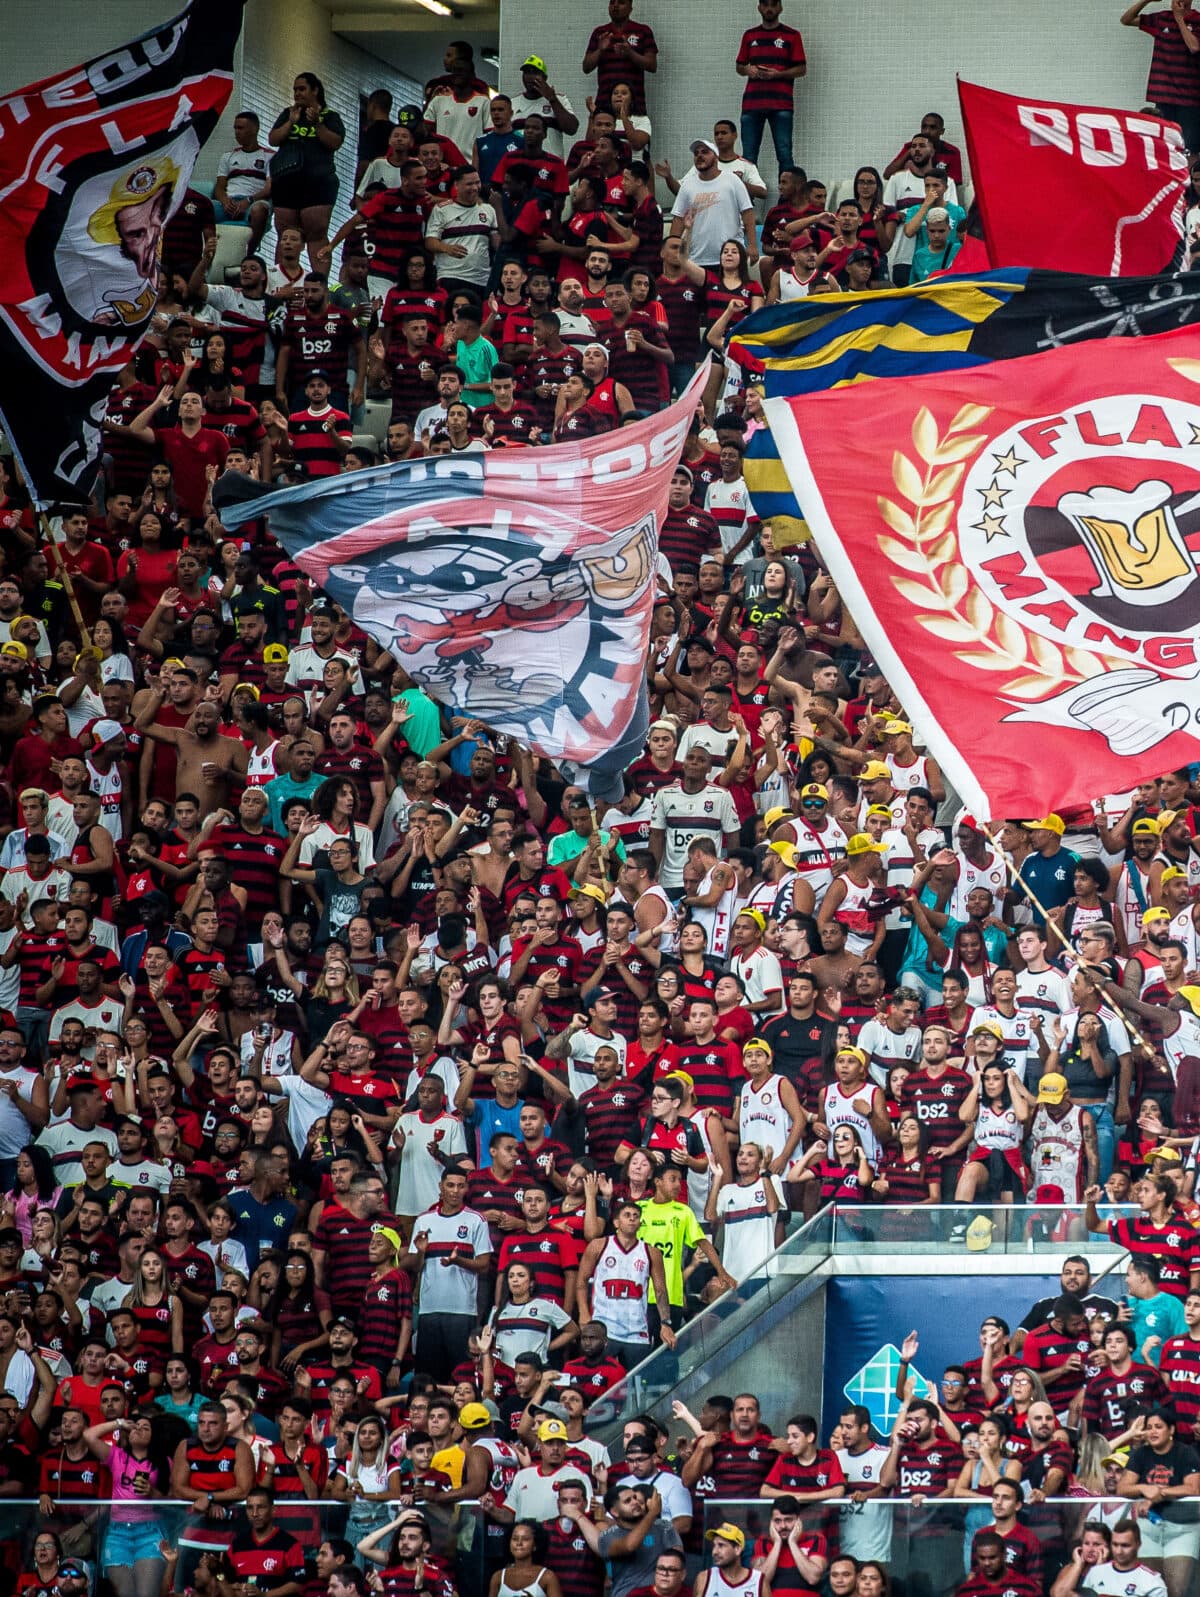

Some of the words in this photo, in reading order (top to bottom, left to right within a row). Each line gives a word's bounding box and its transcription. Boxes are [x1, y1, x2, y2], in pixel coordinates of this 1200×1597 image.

[36, 94, 194, 195] FLA
[302, 337, 331, 355] bs2
[1017, 403, 1182, 460] FLA
[674, 830, 694, 847] bs
[717, 911, 729, 953] TFM
[917, 1101, 949, 1120] bs2
[653, 1242, 674, 1259] s2
[602, 1279, 644, 1300] TFM
[901, 1467, 931, 1486] bs2
